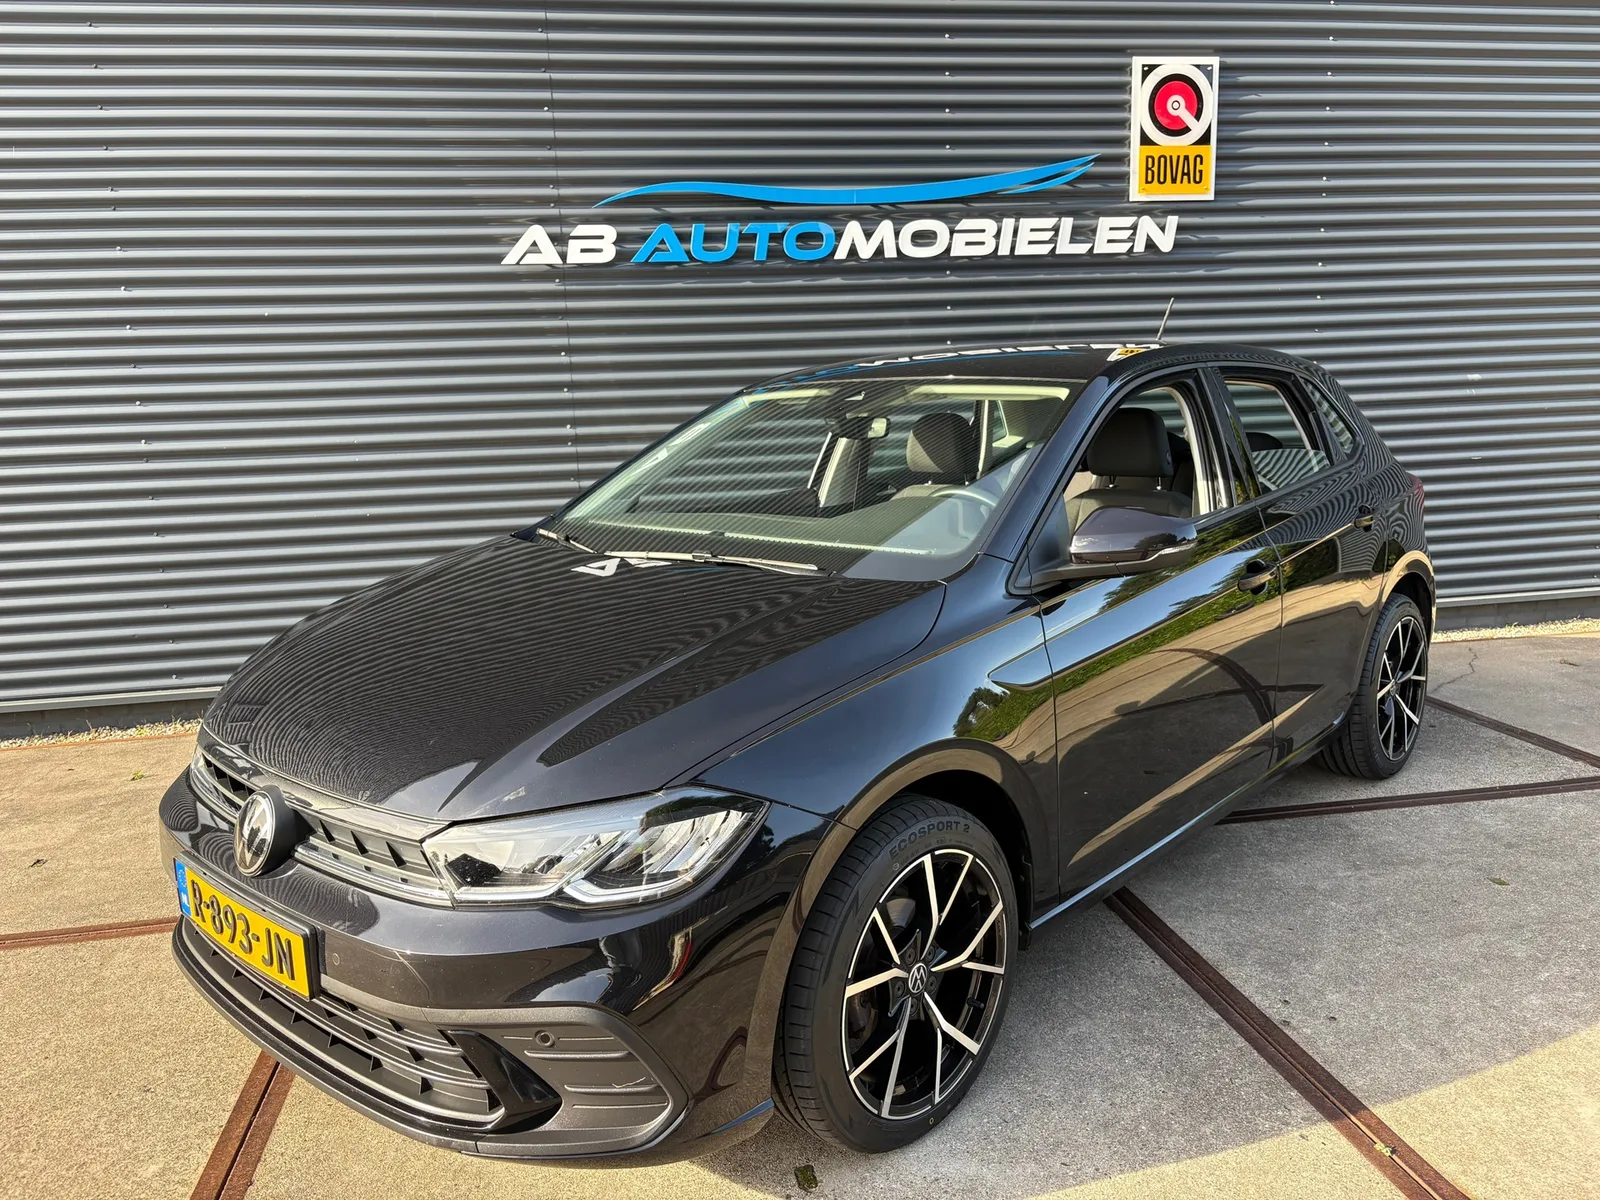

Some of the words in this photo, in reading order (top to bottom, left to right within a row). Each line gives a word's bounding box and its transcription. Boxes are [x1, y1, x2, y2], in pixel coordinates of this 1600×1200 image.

[1144, 154, 1204, 184] BOVAG
[500, 224, 617, 265] AB
[630, 215, 1178, 263] AUTOMOBIELEN
[889, 821, 960, 859] ECOSPORT
[963, 823, 970, 833] 2
[191, 879, 295, 980] R-893-JN
